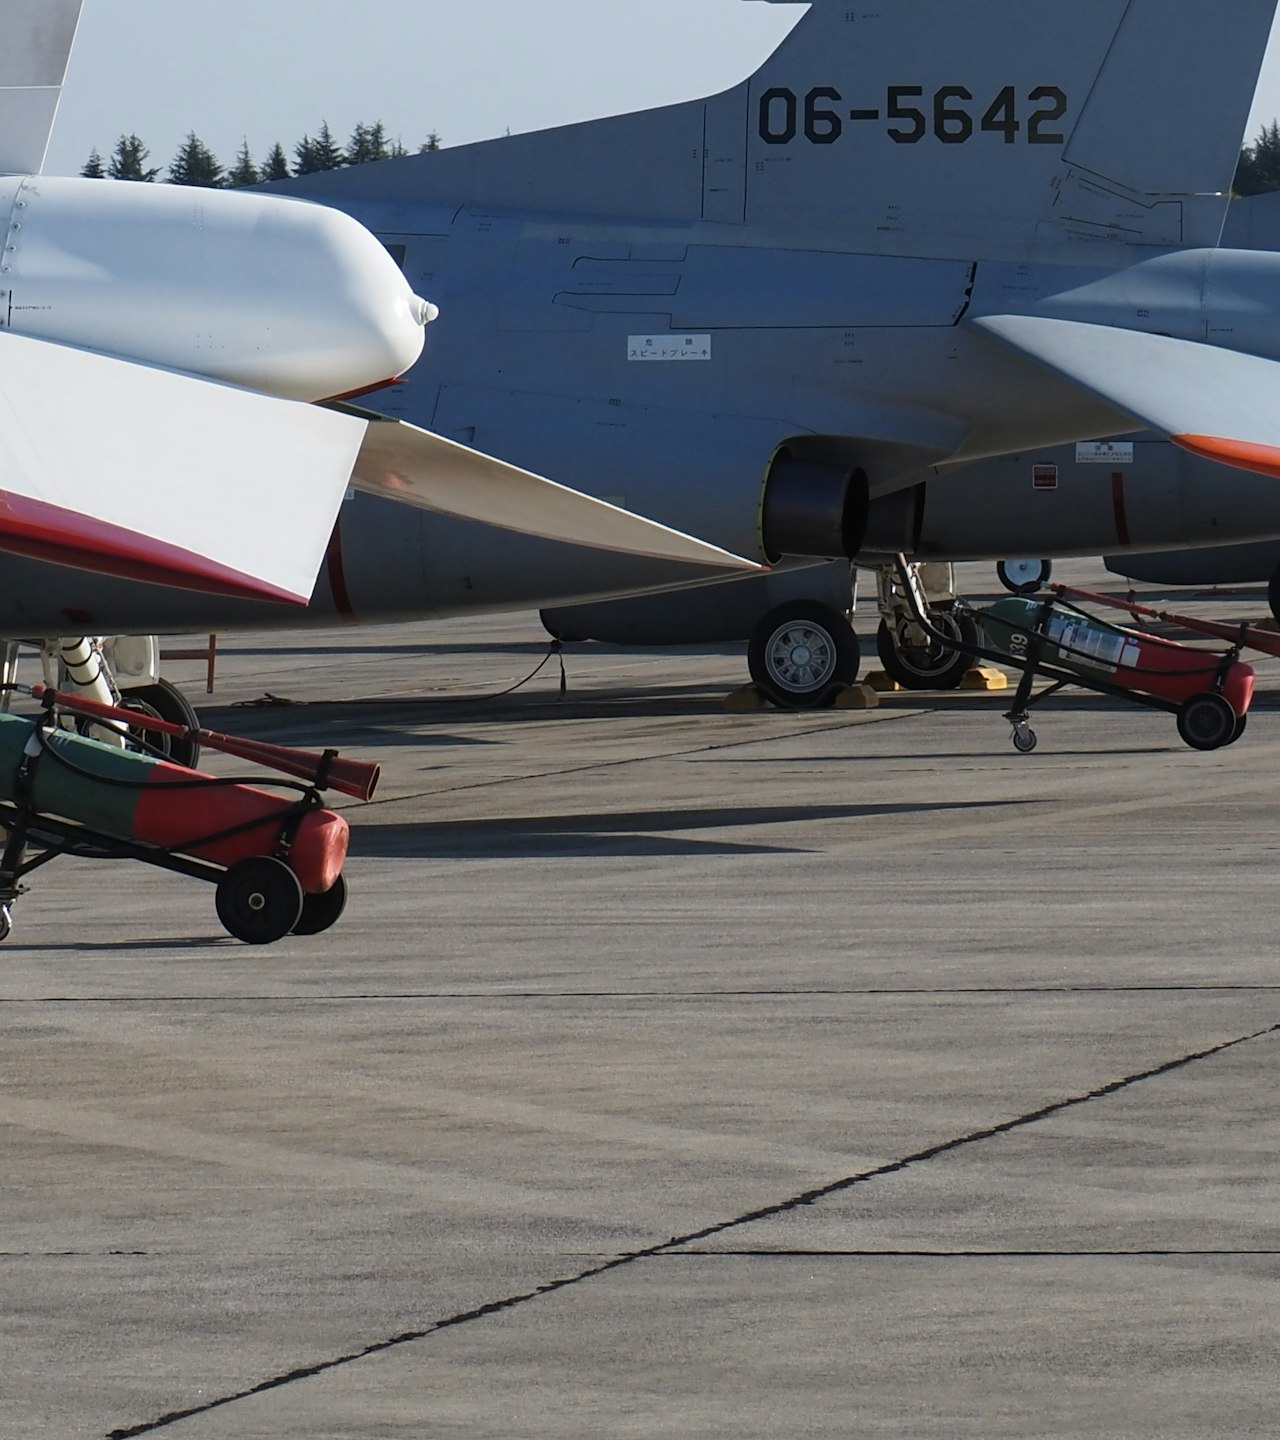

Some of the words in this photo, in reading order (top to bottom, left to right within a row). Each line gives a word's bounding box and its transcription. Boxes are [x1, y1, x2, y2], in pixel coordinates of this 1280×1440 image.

[758, 85, 1068, 145] 06-5642
[630, 349, 709, 358] スピードブレーキ
